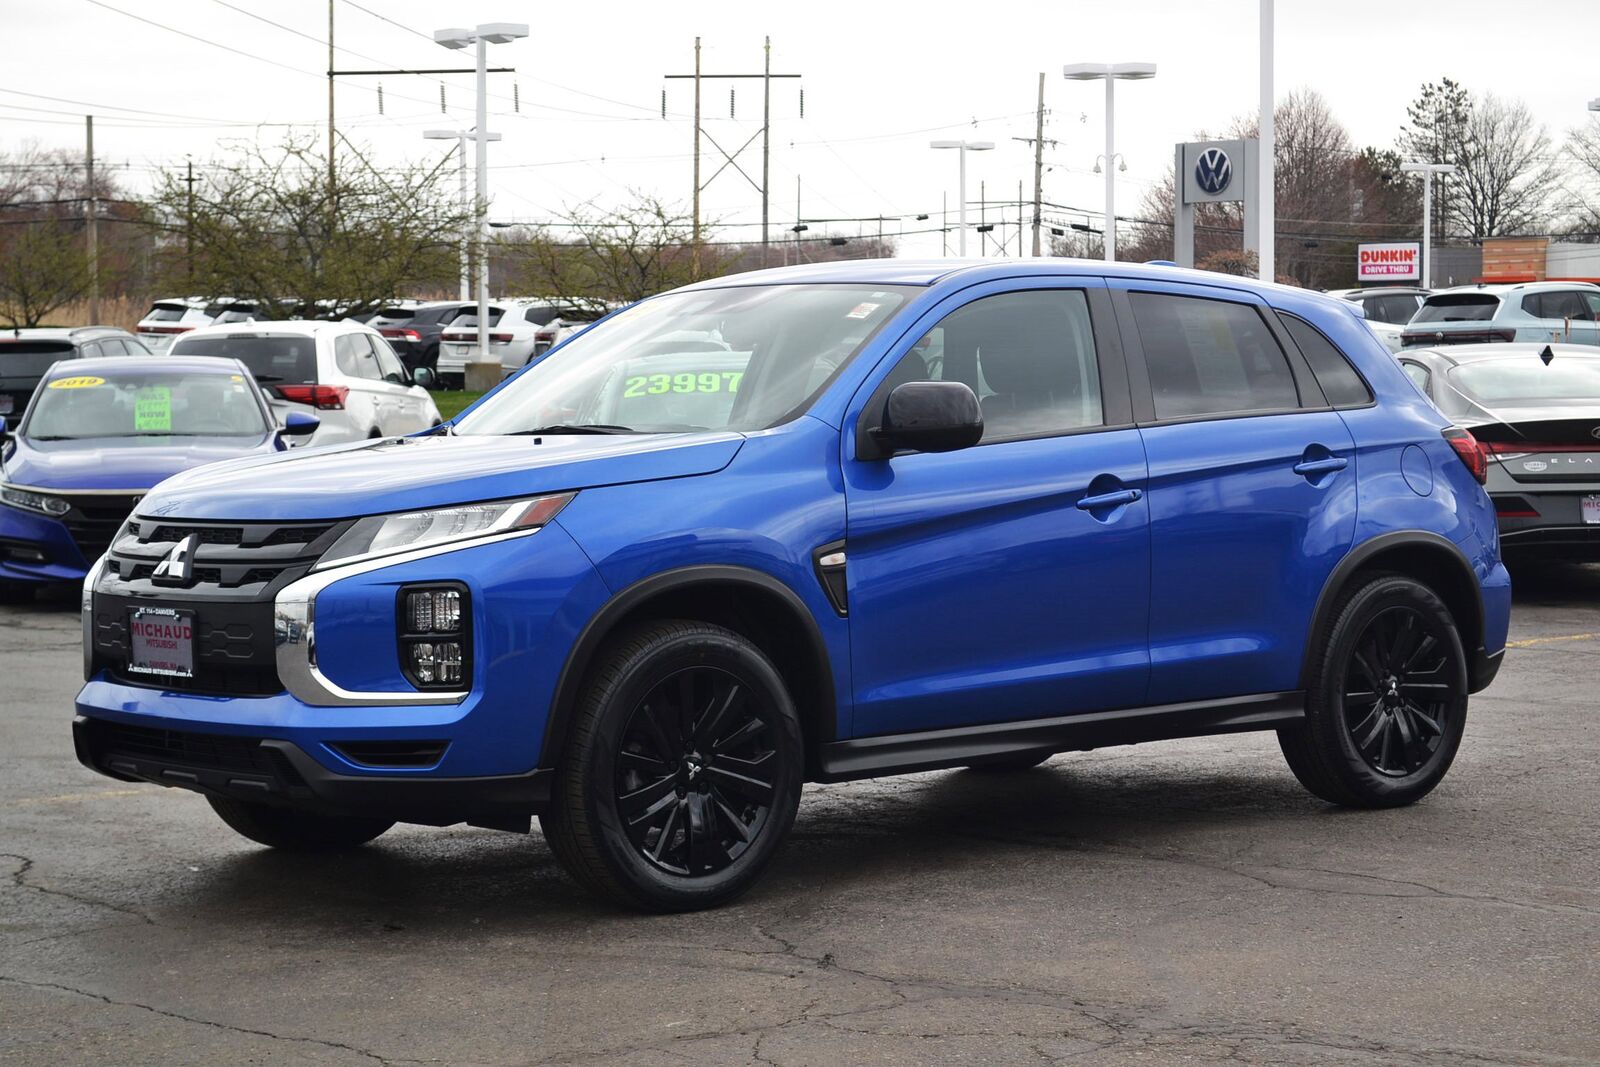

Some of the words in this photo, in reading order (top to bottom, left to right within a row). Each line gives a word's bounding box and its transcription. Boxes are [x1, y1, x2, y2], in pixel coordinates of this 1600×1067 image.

[1196, 148, 1232, 196] VW
[1361, 250, 1416, 262] DUNKIN'
[1389, 265, 1409, 273] THRU
[54, 378, 98, 387] 2019
[624, 372, 744, 398] 23997
[131, 622, 192, 639] MICHAUD
[146, 639, 178, 650] MITSUBISHI
